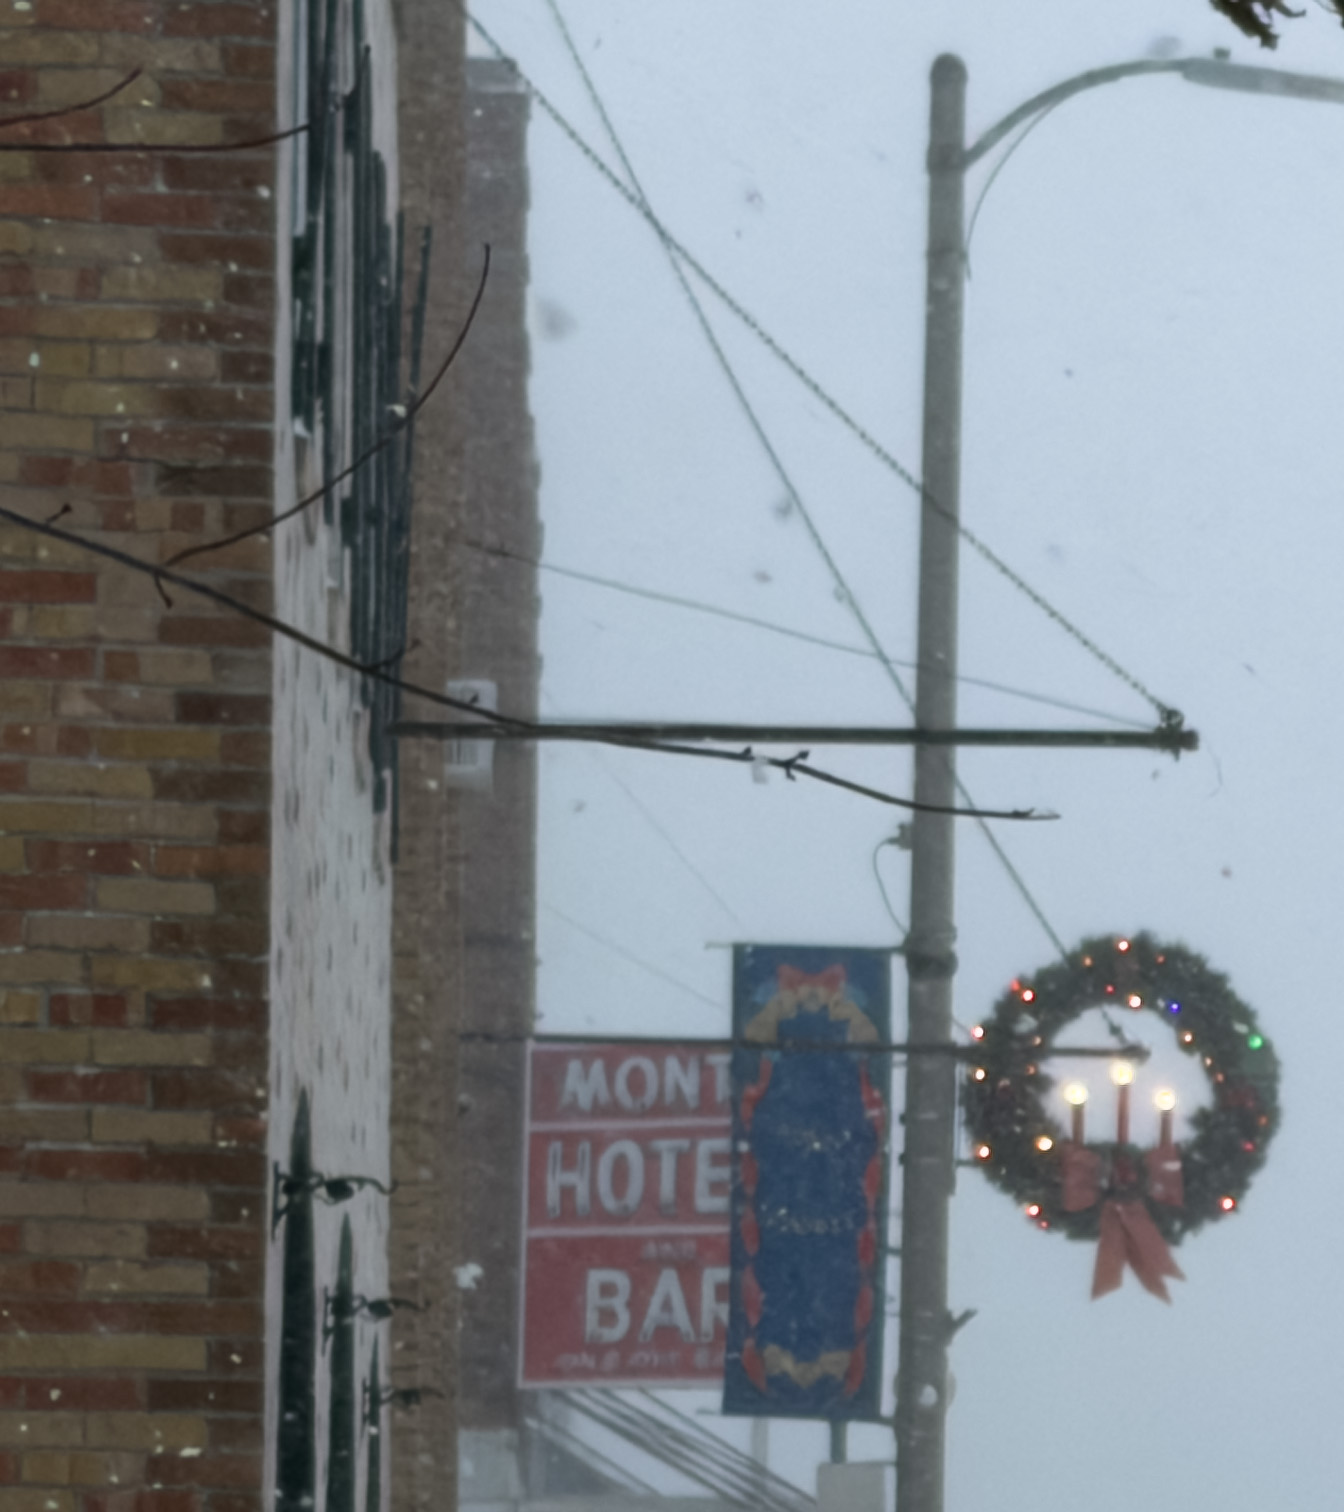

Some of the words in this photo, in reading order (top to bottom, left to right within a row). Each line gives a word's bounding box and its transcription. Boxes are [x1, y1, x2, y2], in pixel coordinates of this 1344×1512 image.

[557, 1053, 732, 1113] MONT
[545, 1138, 732, 1219] HOTE
[585, 1266, 730, 1344] BAR
